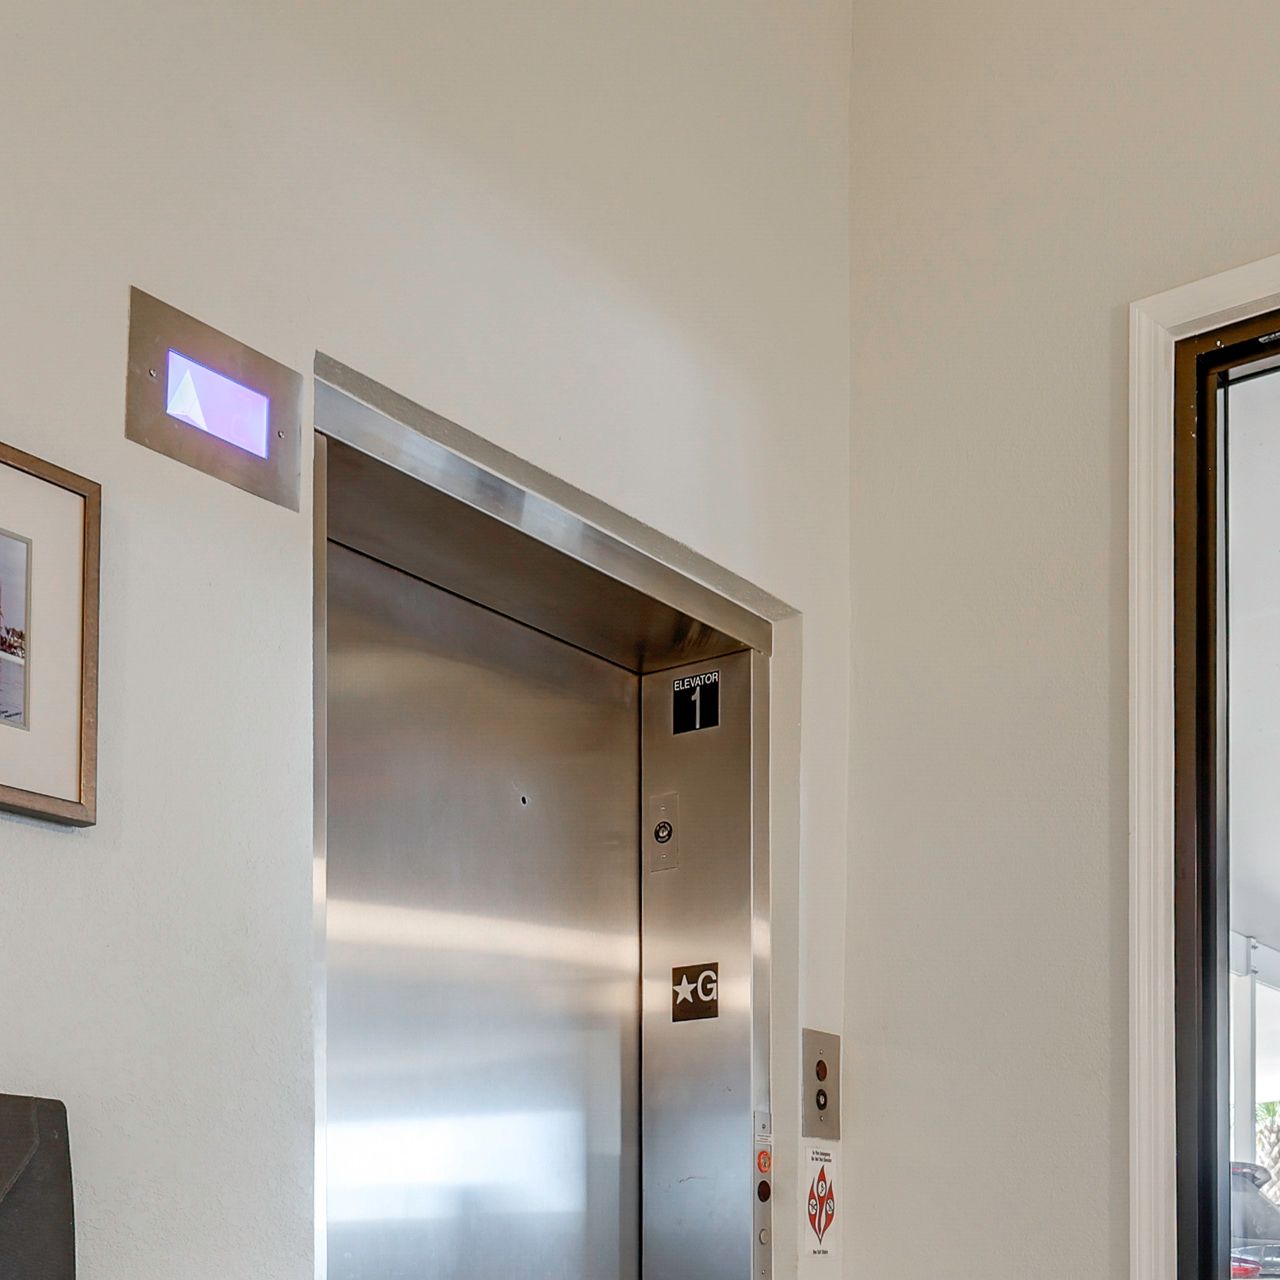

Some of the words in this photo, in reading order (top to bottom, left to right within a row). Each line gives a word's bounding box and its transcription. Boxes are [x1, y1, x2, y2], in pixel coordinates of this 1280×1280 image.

[674, 672, 719, 691] ELEVATOR
[691, 686, 700, 729] 1
[697, 970, 717, 1002] G
